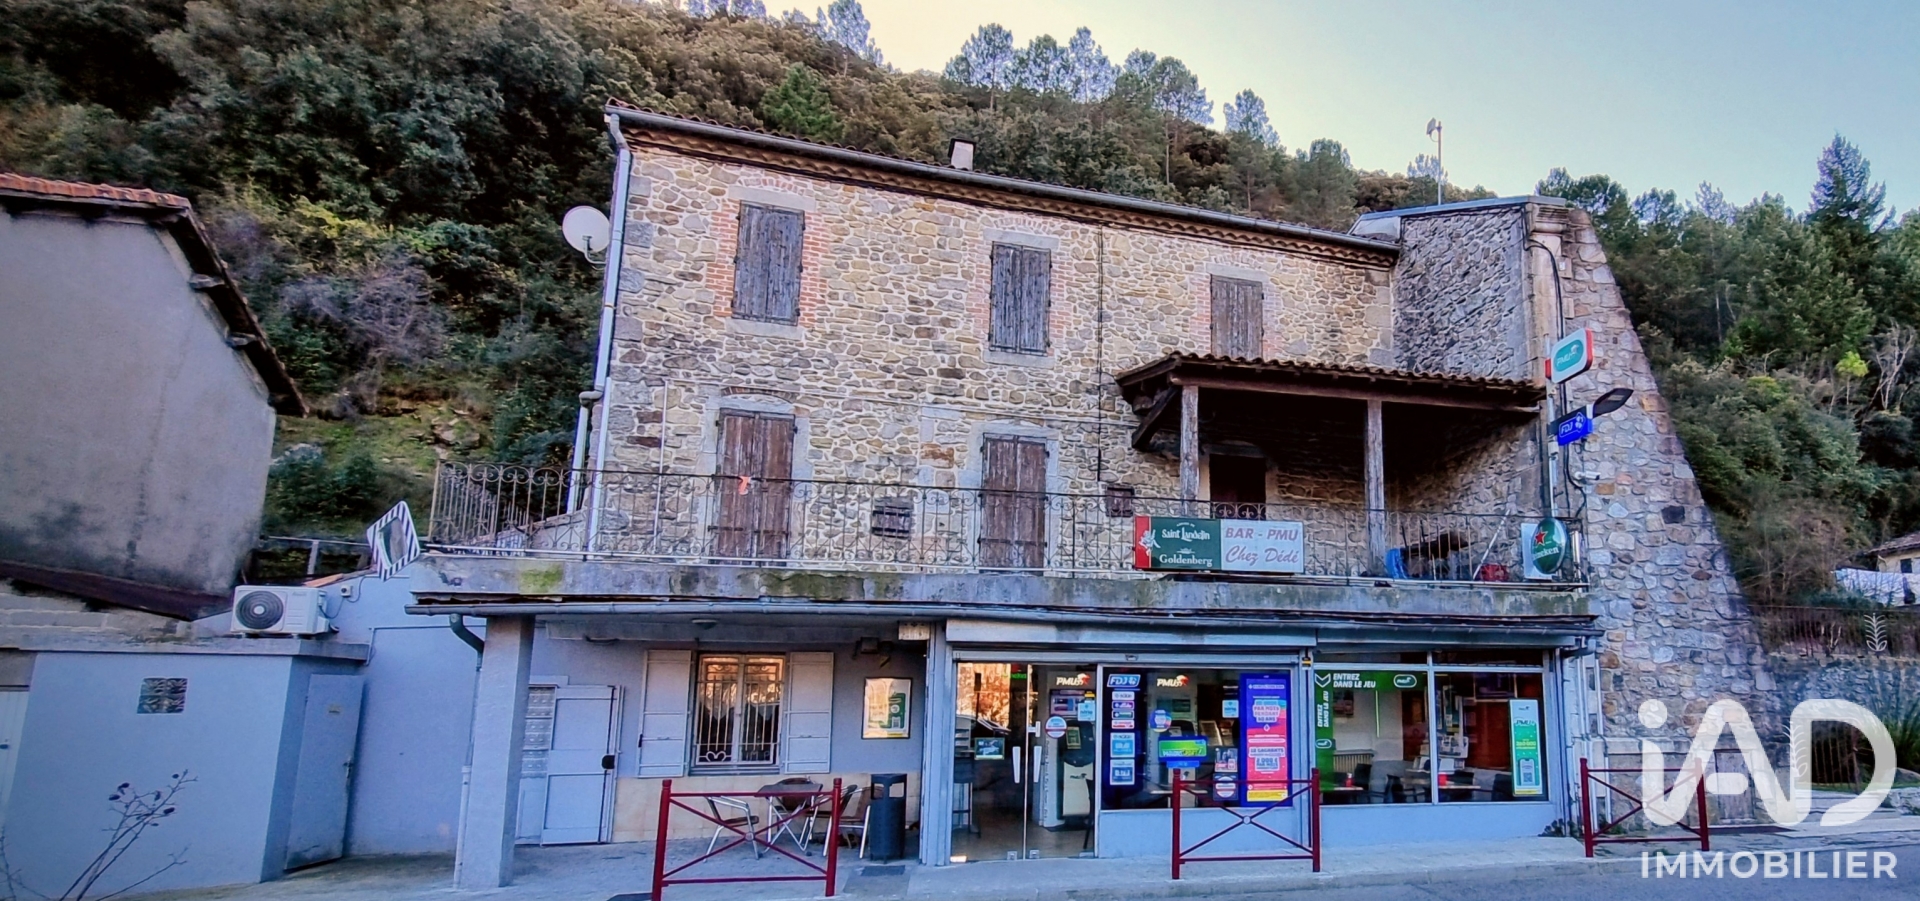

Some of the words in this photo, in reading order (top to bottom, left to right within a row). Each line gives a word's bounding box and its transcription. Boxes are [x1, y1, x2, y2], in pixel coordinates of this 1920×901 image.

[1561, 421, 1574, 434] FDJ
[1161, 528, 1181, 539] Saint
[1225, 527, 1254, 539] BAR
[1266, 529, 1299, 541] PMU
[1159, 553, 1213, 567] Goldenberg
[1225, 545, 1259, 566] Chez
[1264, 547, 1299, 564] Dédé
[1056, 676, 1076, 686] PMU
[1110, 676, 1128, 685] FDJ
[1156, 678, 1177, 687] PMU
